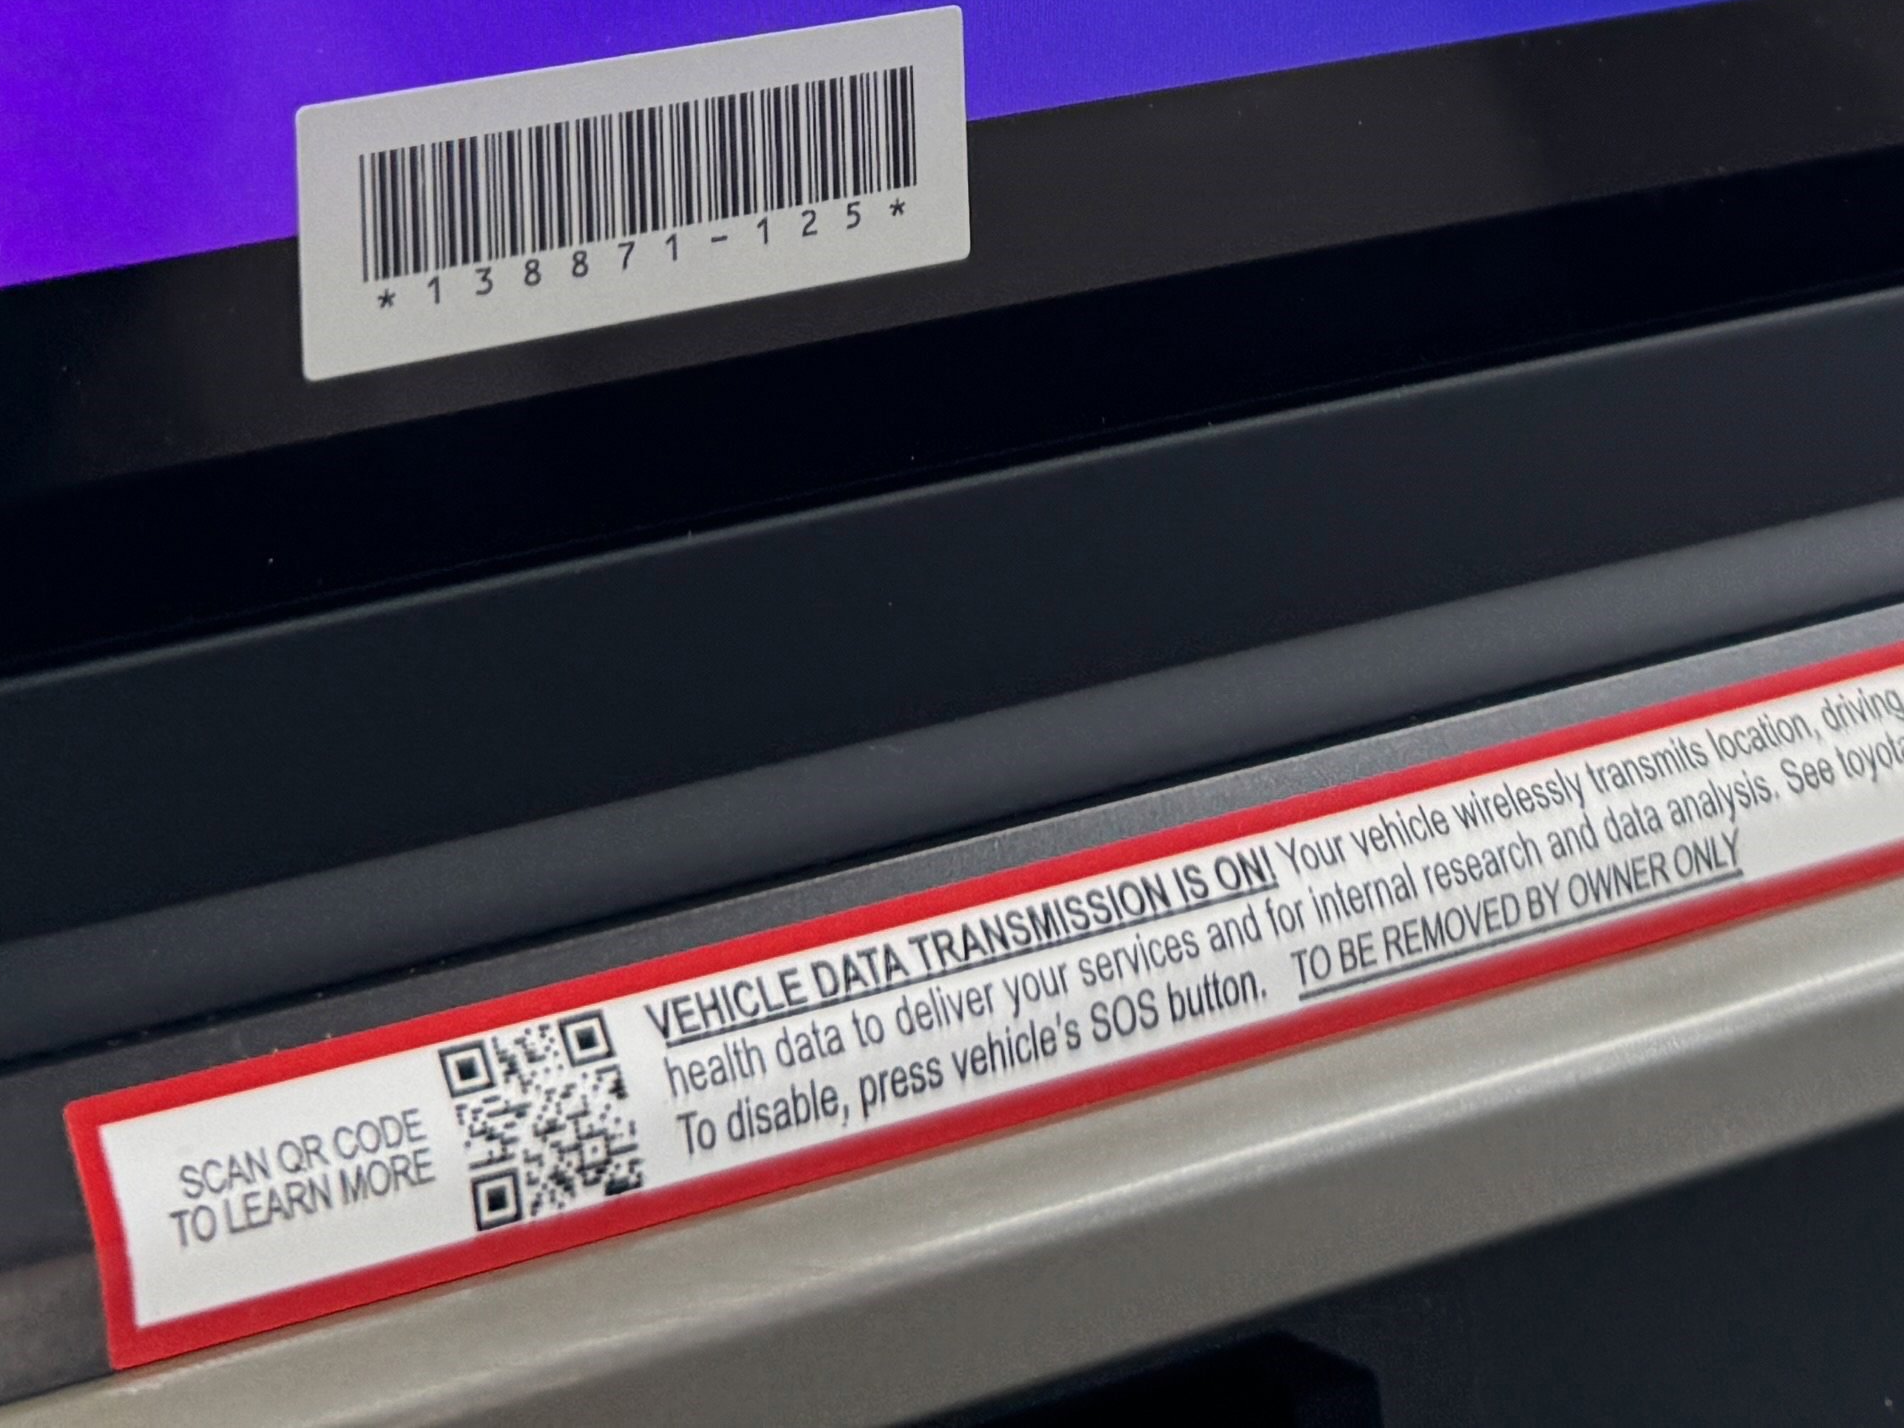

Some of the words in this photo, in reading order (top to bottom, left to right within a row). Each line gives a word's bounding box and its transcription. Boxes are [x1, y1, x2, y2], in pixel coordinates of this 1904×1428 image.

[643, 966, 808, 1040] VEHICLE
[811, 943, 909, 998] DATA
[909, 872, 1172, 971] TRANSMISSION
[1174, 863, 1209, 903] IS
[1214, 845, 1277, 890] ON!
[1275, 832, 1345, 874] Your
[1350, 804, 1450, 857] vehicle
[1451, 768, 1586, 830] wirelessly
[1586, 738, 1709, 794] transmits
[1705, 712, 1822, 762] location,
[664, 1037, 767, 1097] health
[775, 1020, 845, 1067] data
[851, 1009, 884, 1048] to
[895, 981, 993, 1036] deliver
[1003, 961, 1068, 1018] your
[1078, 928, 1200, 987] services
[1207, 902, 1263, 955] and
[1265, 896, 1312, 939] for
[1308, 862, 1419, 926] internal
[1423, 831, 1543, 894] research
[1547, 811, 1598, 861] and
[1603, 802, 1663, 845] data
[1667, 770, 1780, 827] analysis.
[1780, 756, 1834, 794] See
[676, 1110, 716, 1155] To
[727, 1079, 850, 1142] disable,
[859, 1055, 944, 1118] press
[951, 1012, 1081, 1081] vehicle's
[1090, 989, 1159, 1042] SOS
[1167, 969, 1268, 1023] button.
[1291, 942, 1332, 987] TO
[1338, 930, 1377, 975] BE
[1383, 892, 1521, 962] REMOVED
[1526, 877, 1561, 922] BY
[1568, 851, 1670, 910] OWNER
[1673, 827, 1741, 878] ONLY
[169, 1205, 217, 1246] TO
[224, 1173, 334, 1234] LEARN
[340, 1147, 436, 1205] MORE
[179, 1147, 271, 1199] SCAN
[277, 1134, 329, 1174] QR
[333, 1107, 427, 1160] CODE
